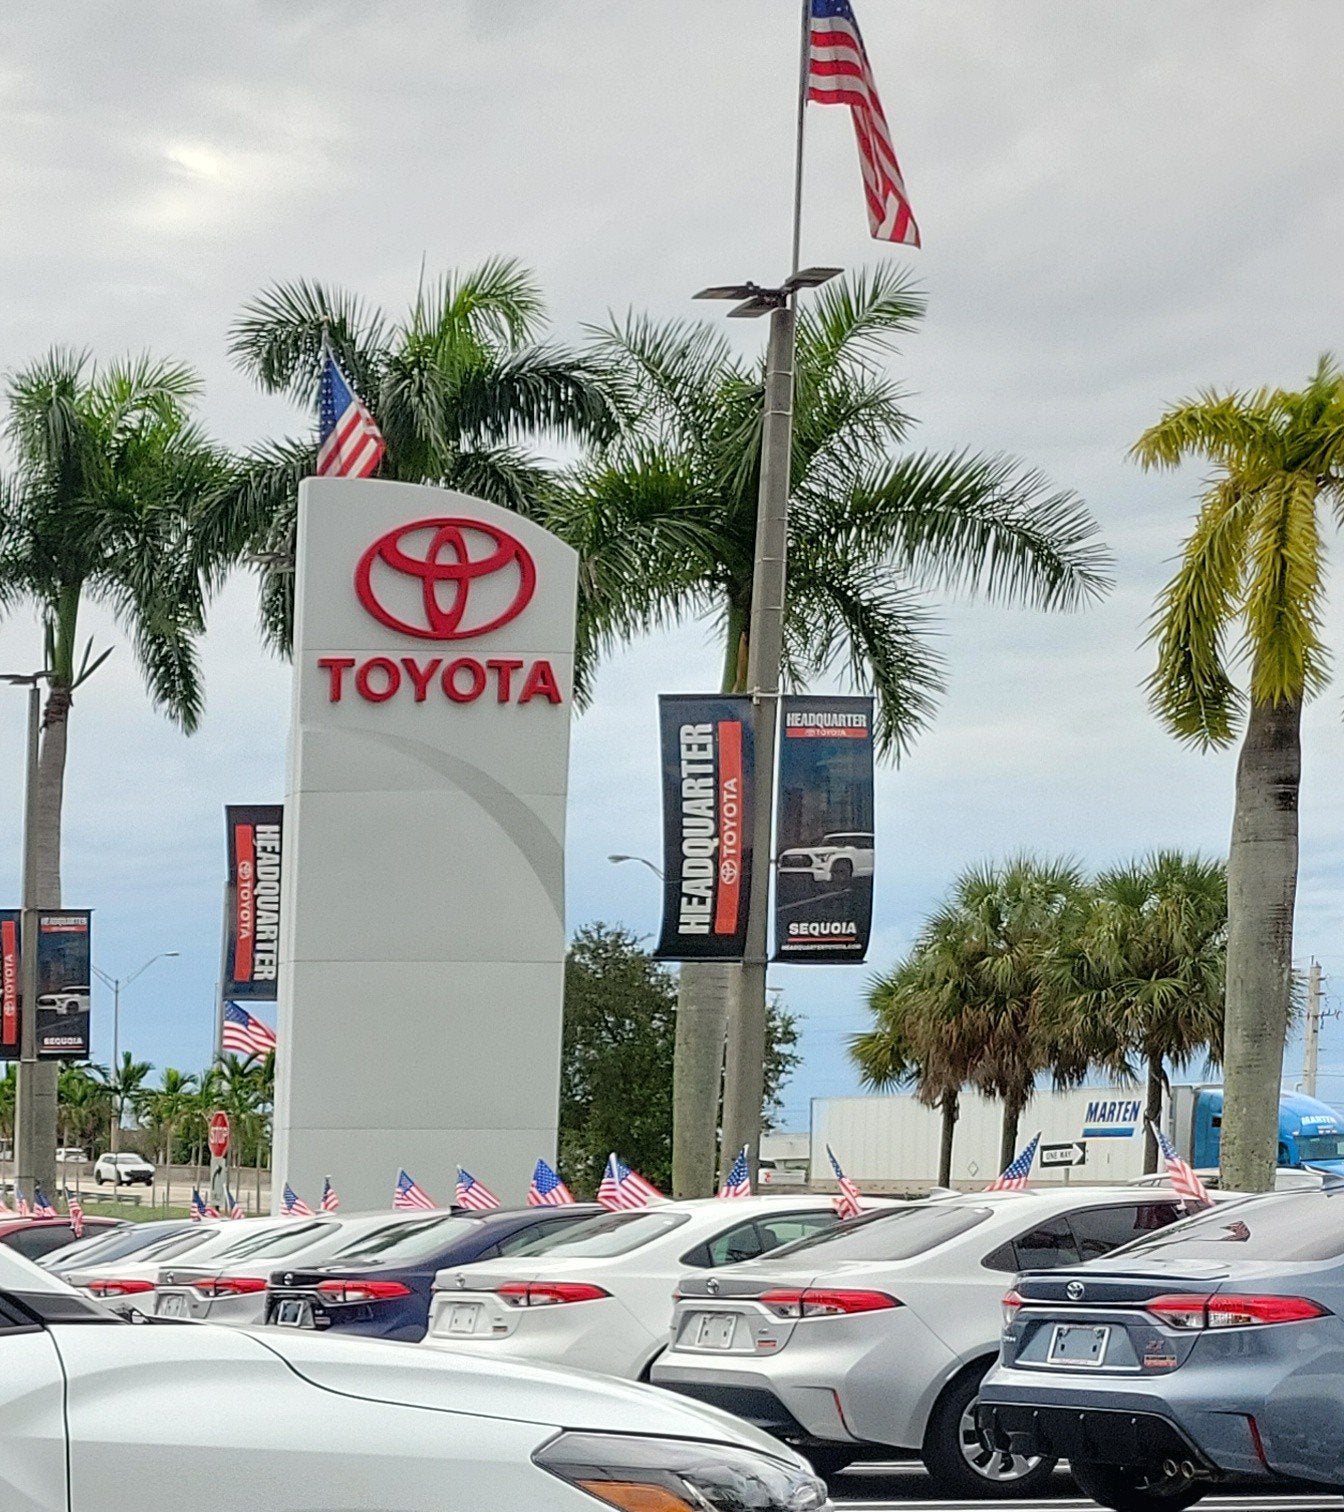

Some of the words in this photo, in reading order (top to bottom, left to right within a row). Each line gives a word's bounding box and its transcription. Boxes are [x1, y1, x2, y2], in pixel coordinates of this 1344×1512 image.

[318, 657, 562, 704] TOYOTA
[786, 712, 867, 728] HEADQUARTER
[678, 722, 719, 935] HEADQUARTER
[722, 777, 738, 858] TOYOTA
[240, 880, 252, 940] TOYOTA
[253, 824, 281, 981] HEADQUARTER
[788, 921, 858, 936] SEQUOIA
[4, 954, 15, 1004] TOYOTA
[1085, 1100, 1141, 1122] MARTEN
[1046, 1152, 1058, 1160] ONE
[1060, 1151, 1072, 1159] WAY
